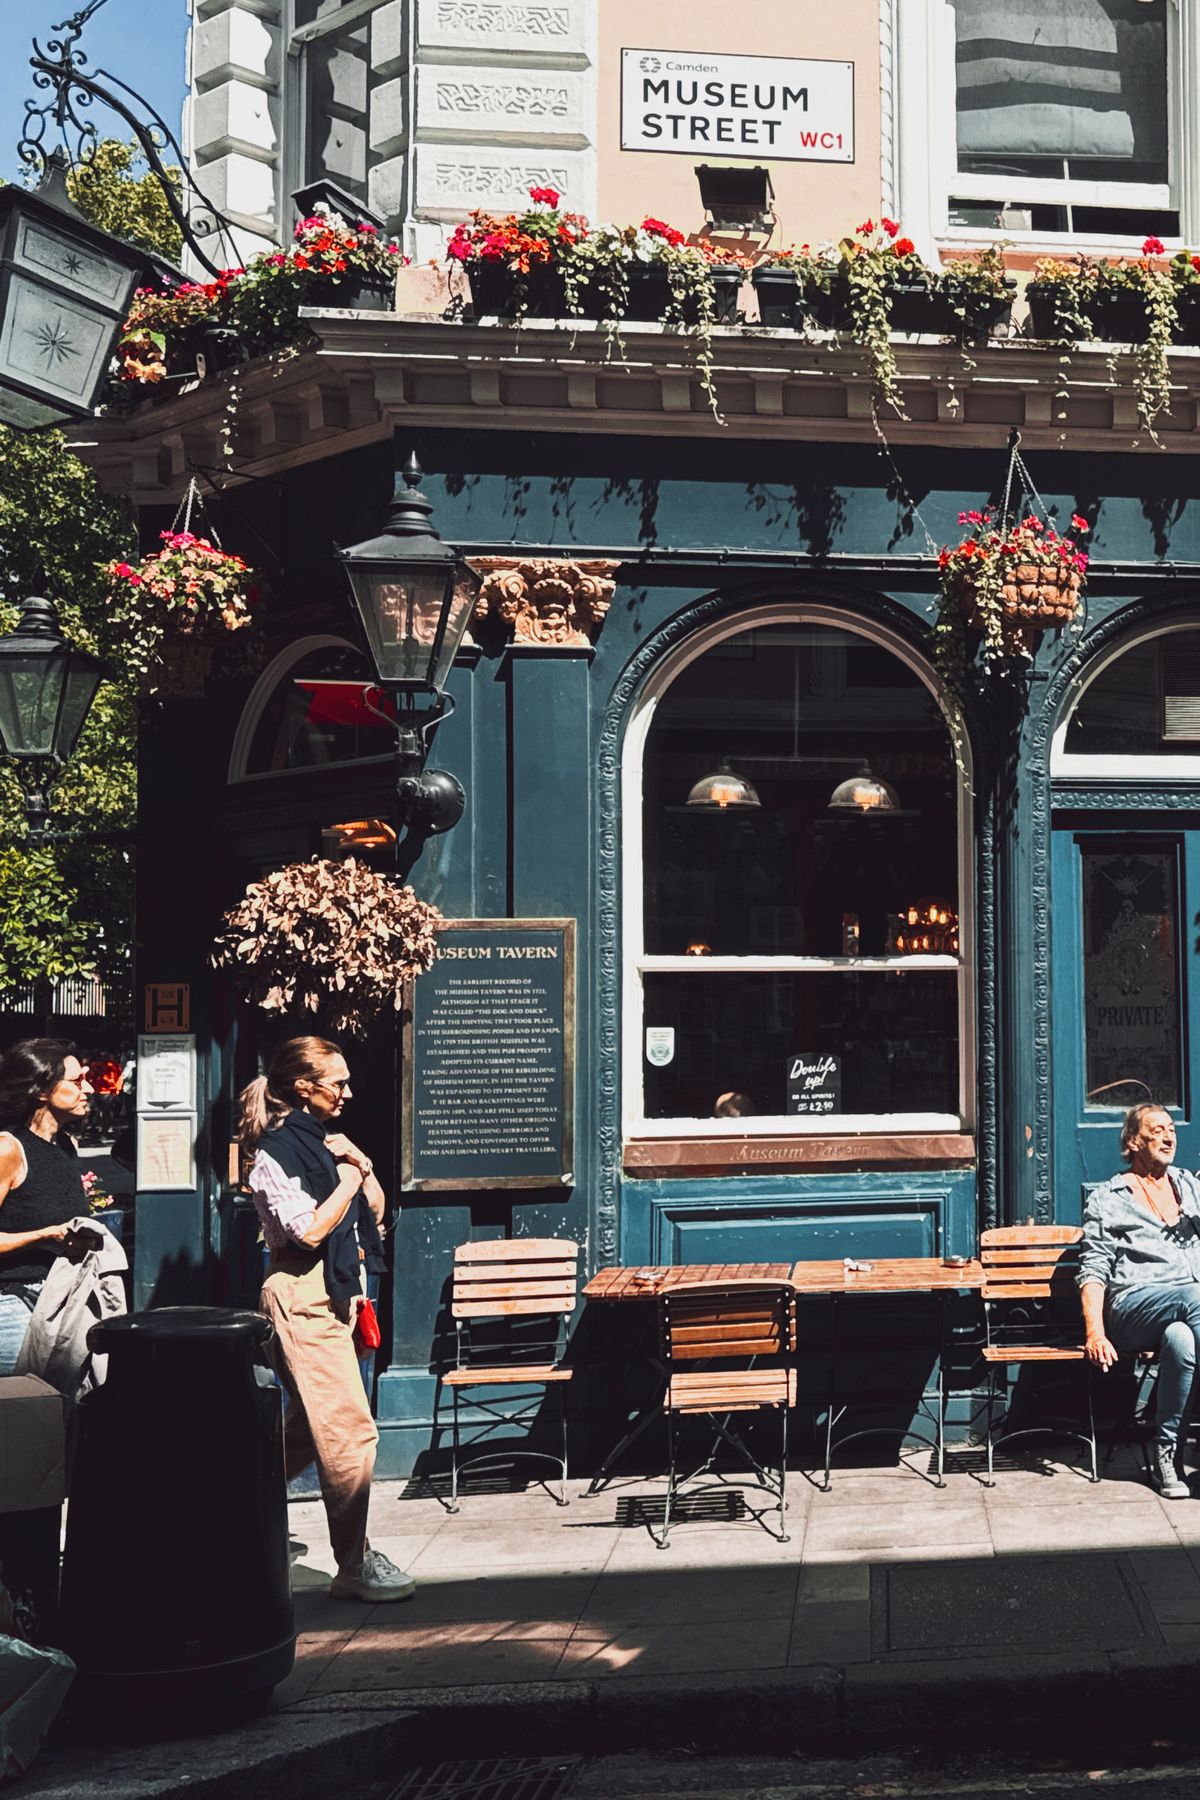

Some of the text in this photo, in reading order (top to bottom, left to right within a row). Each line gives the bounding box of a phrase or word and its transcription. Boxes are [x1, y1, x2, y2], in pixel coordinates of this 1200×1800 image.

[666, 61, 719, 73] Camden
[643, 78, 808, 112] MUSEUM
[641, 113, 843, 149] STREET WC1
[433, 946, 558, 960] USEUM TAVERN
[1097, 1004, 1164, 1027] PRIVATE
[790, 1056, 837, 1079] Double
[730, 1144, 804, 1162] Museum
